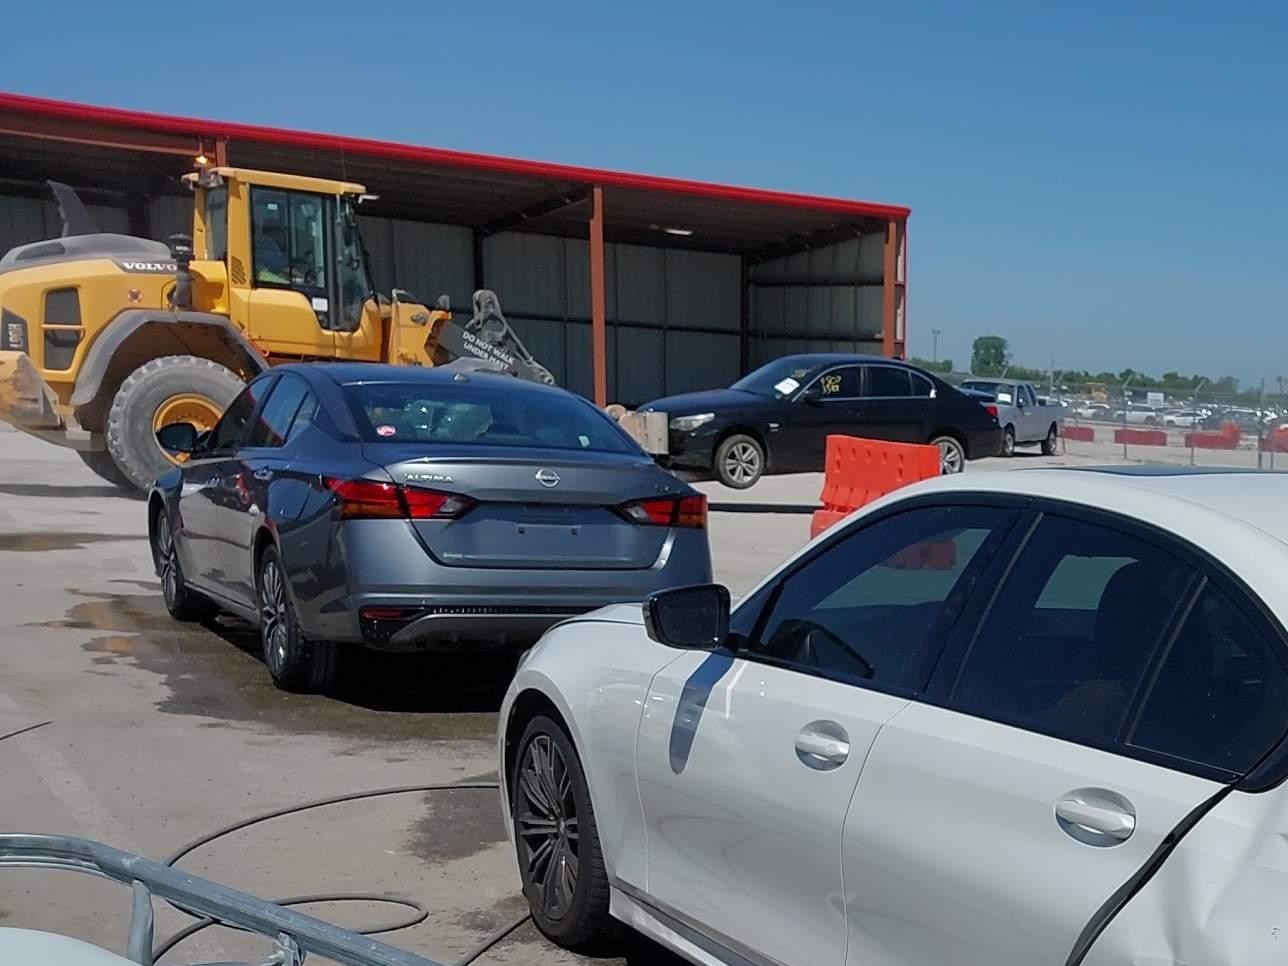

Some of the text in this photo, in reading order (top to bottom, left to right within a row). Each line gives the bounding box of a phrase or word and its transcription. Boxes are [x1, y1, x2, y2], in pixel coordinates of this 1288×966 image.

[122, 262, 178, 271] VOLVO
[462, 331, 515, 365] DO NOT WALK
[463, 342, 489, 359] UNDER
